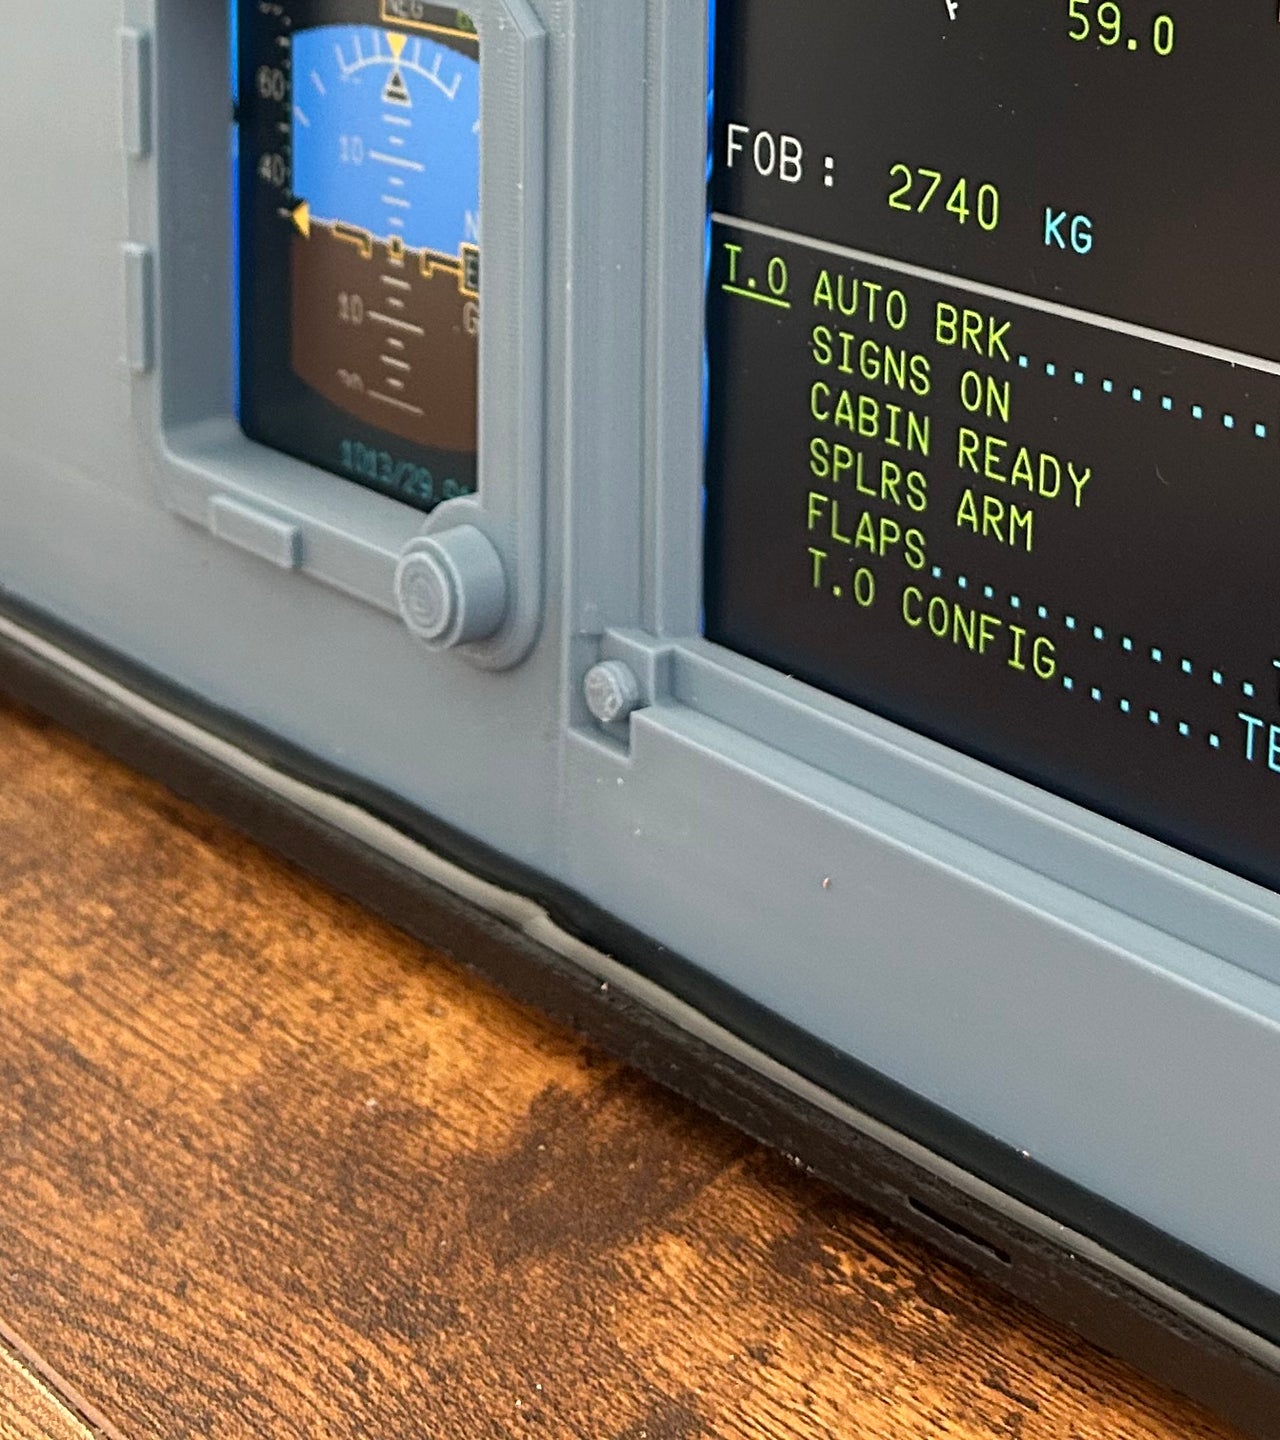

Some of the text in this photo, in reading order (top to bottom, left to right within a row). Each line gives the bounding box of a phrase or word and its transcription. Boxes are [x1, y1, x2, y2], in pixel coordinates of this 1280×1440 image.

[888, 163, 1093, 253] 2740 KG
[812, 270, 907, 332] AUTO
[812, 326, 1011, 423] SIGNS ON
[810, 382, 1092, 507] CABIN READY
[809, 438, 1036, 552] SPLRS ARM
[808, 547, 875, 607] T.O
